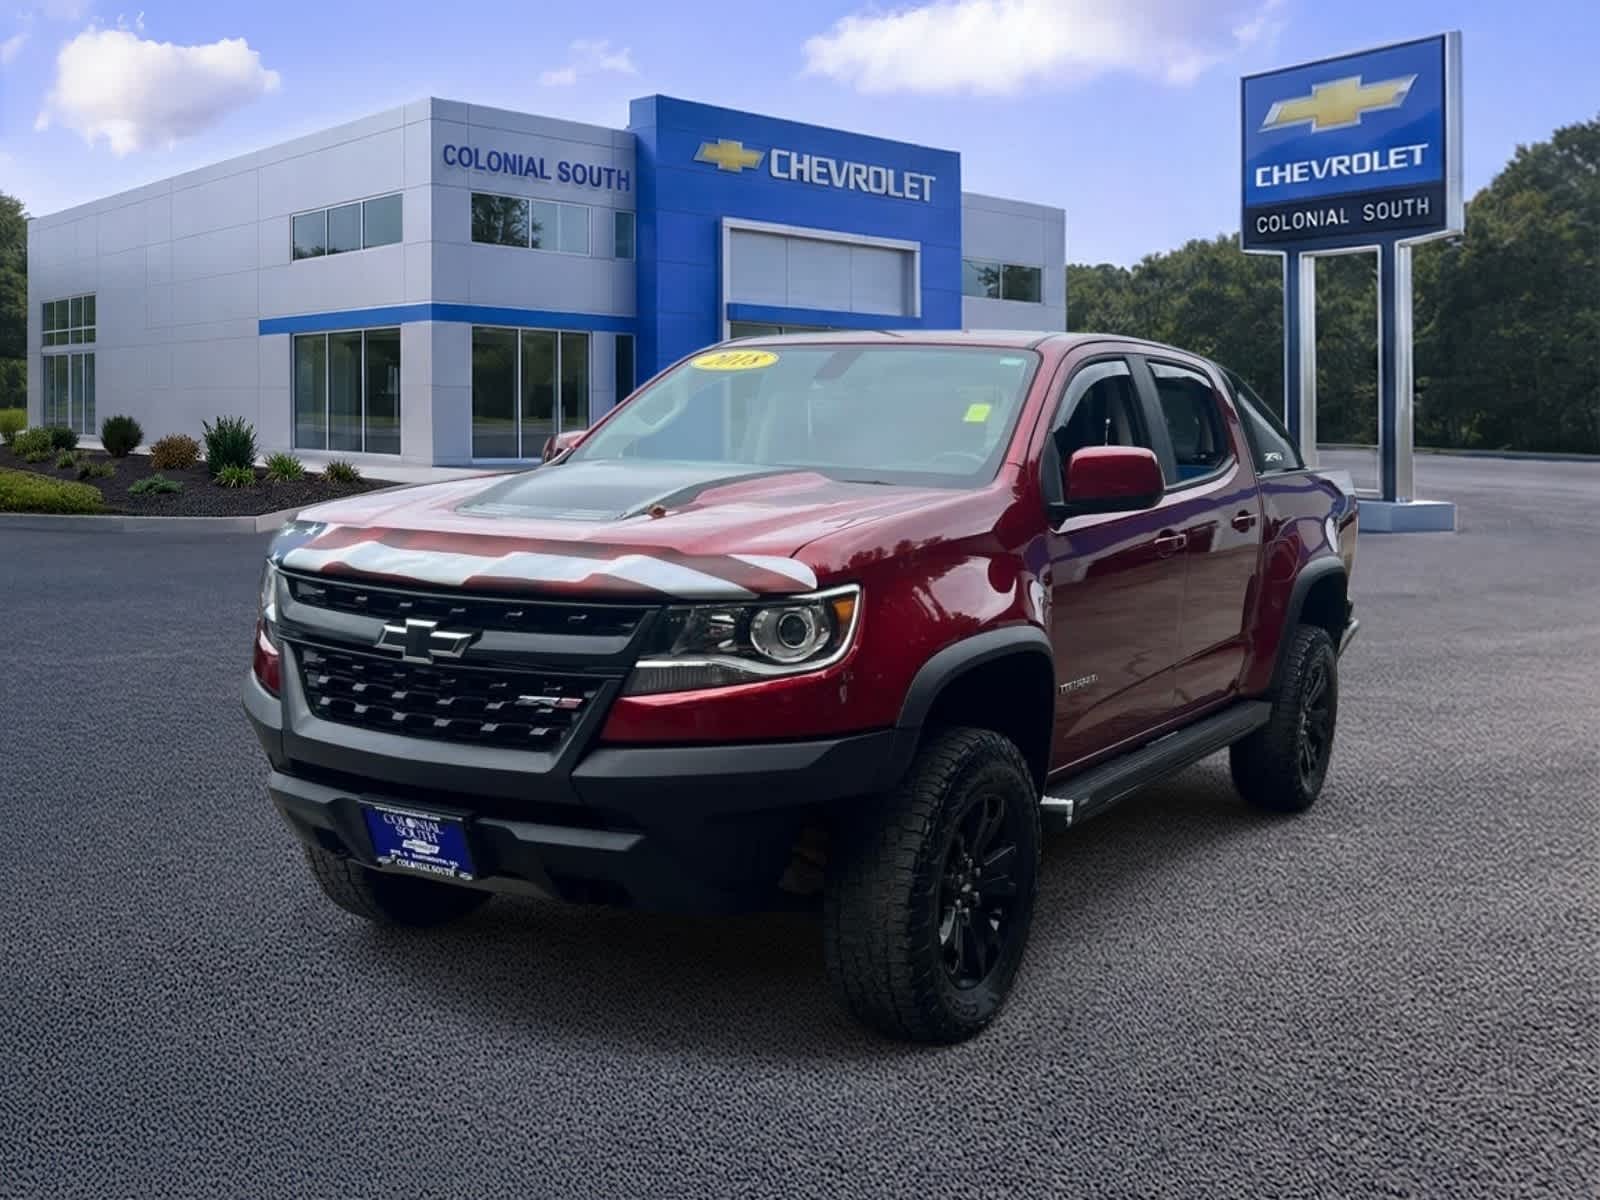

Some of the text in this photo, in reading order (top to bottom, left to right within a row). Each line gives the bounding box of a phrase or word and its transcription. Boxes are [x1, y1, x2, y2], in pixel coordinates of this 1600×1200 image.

[443, 143, 631, 192] COLONIAL SOUTH
[769, 147, 936, 201] CHEVROLET
[1255, 143, 1429, 187] CHEVROLET
[1256, 197, 1430, 234] COLONIAL SOUTH
